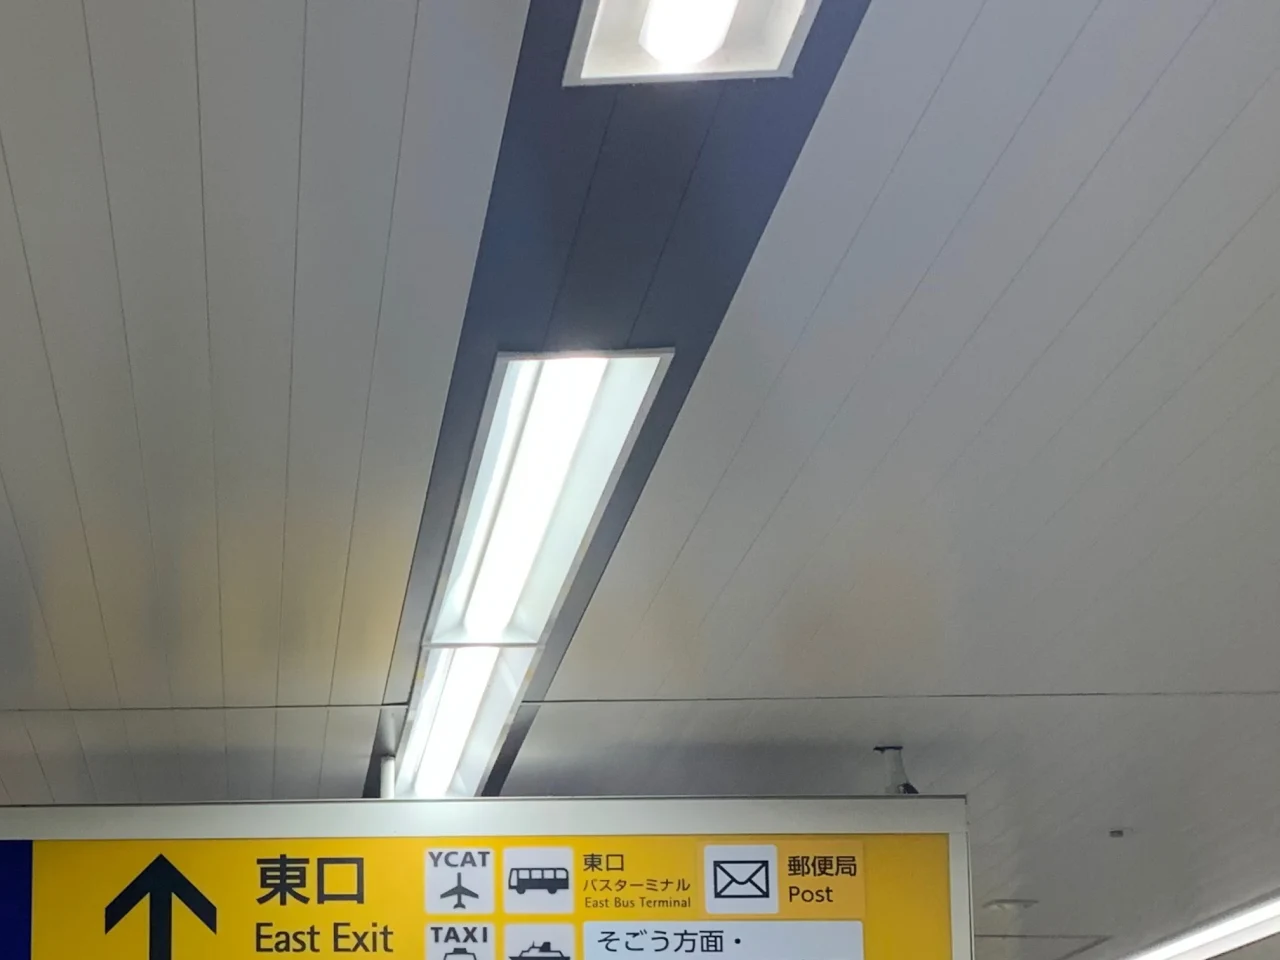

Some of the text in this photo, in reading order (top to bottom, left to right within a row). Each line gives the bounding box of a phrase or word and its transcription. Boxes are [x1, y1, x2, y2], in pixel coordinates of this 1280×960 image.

[428, 851, 490, 868] YCAT
[582, 854, 625, 873] 東口
[787, 855, 857, 877] 郵便局
[256, 854, 365, 906] 東口
[582, 878, 691, 893] バスターミナル
[585, 897, 691, 908] East Bus Terminal
[788, 886, 833, 903] Post
[255, 922, 394, 953] East Exit
[430, 926, 488, 944] TAXI
